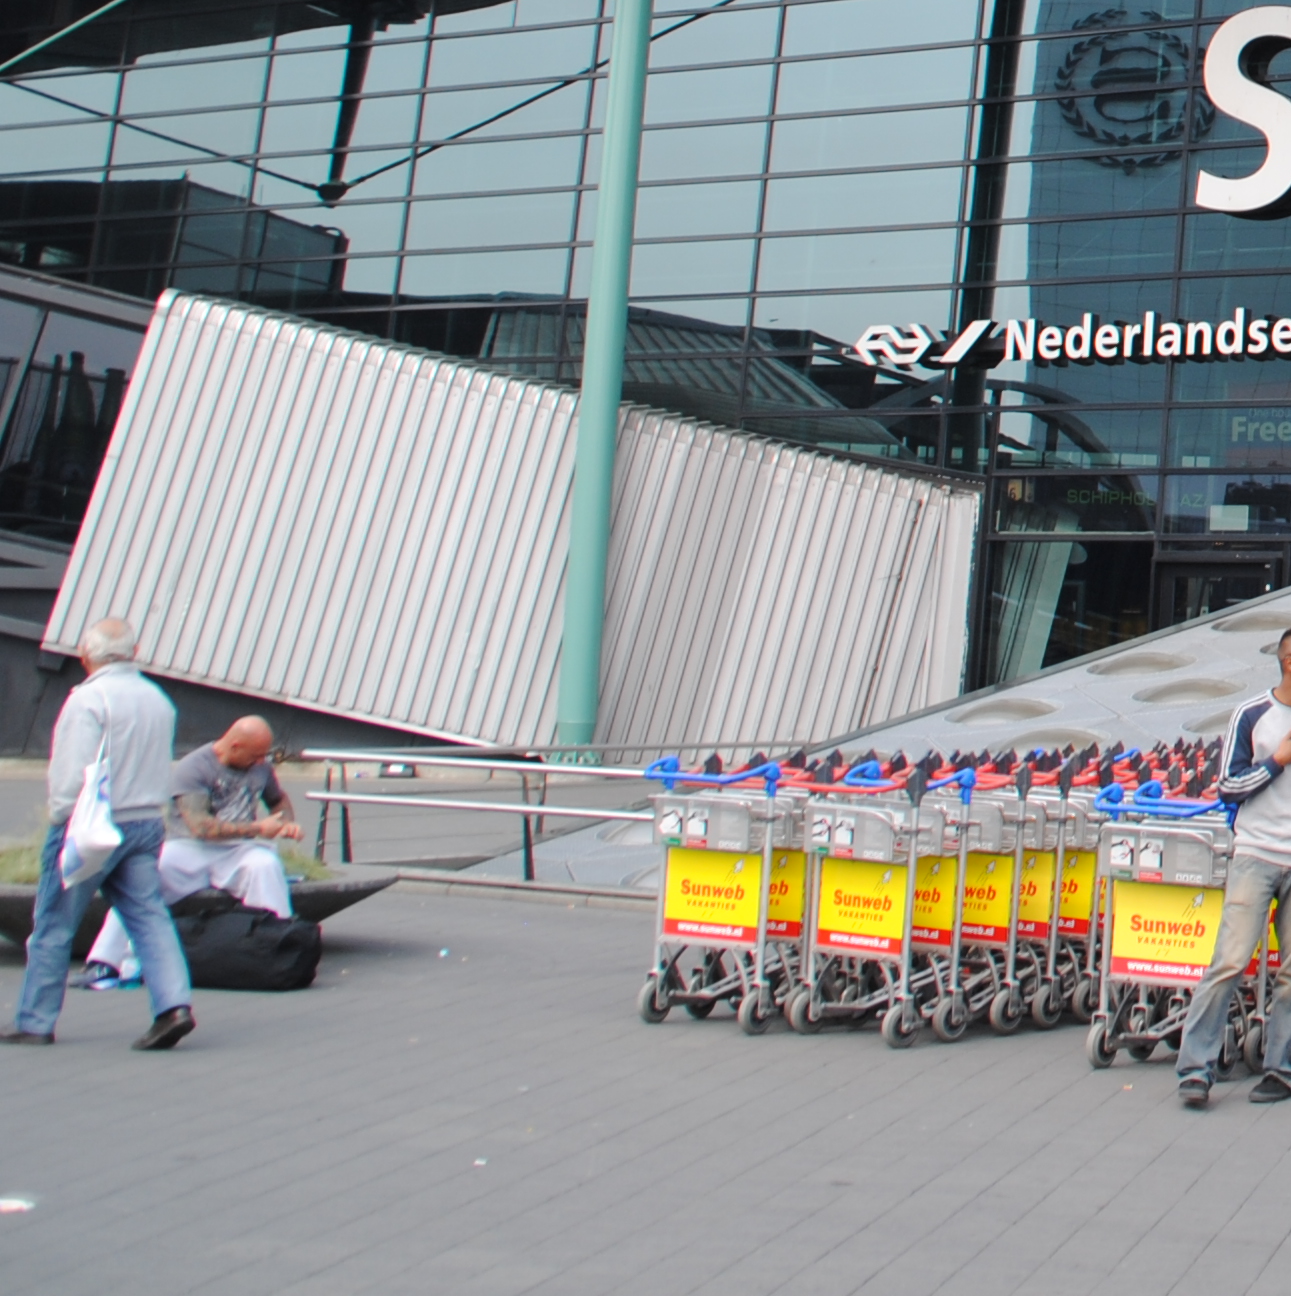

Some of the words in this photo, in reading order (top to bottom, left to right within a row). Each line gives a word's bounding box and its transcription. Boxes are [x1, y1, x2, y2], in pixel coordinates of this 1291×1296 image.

[1067, 489, 1156, 507] SCHIPHOL
[681, 879, 745, 901] Sunweb
[686, 898, 736, 911] VAKANTIES
[833, 889, 892, 912] Sunweb
[838, 909, 884, 922] VAKANTIES
[677, 921, 744, 937] www.sunweb.nl
[1130, 914, 1206, 938] Sunweb
[829, 933, 890, 949] www.sunweb.nl
[1137, 936, 1196, 950] VAKANTIES
[1127, 961, 1204, 977] www.sunweb.nl
